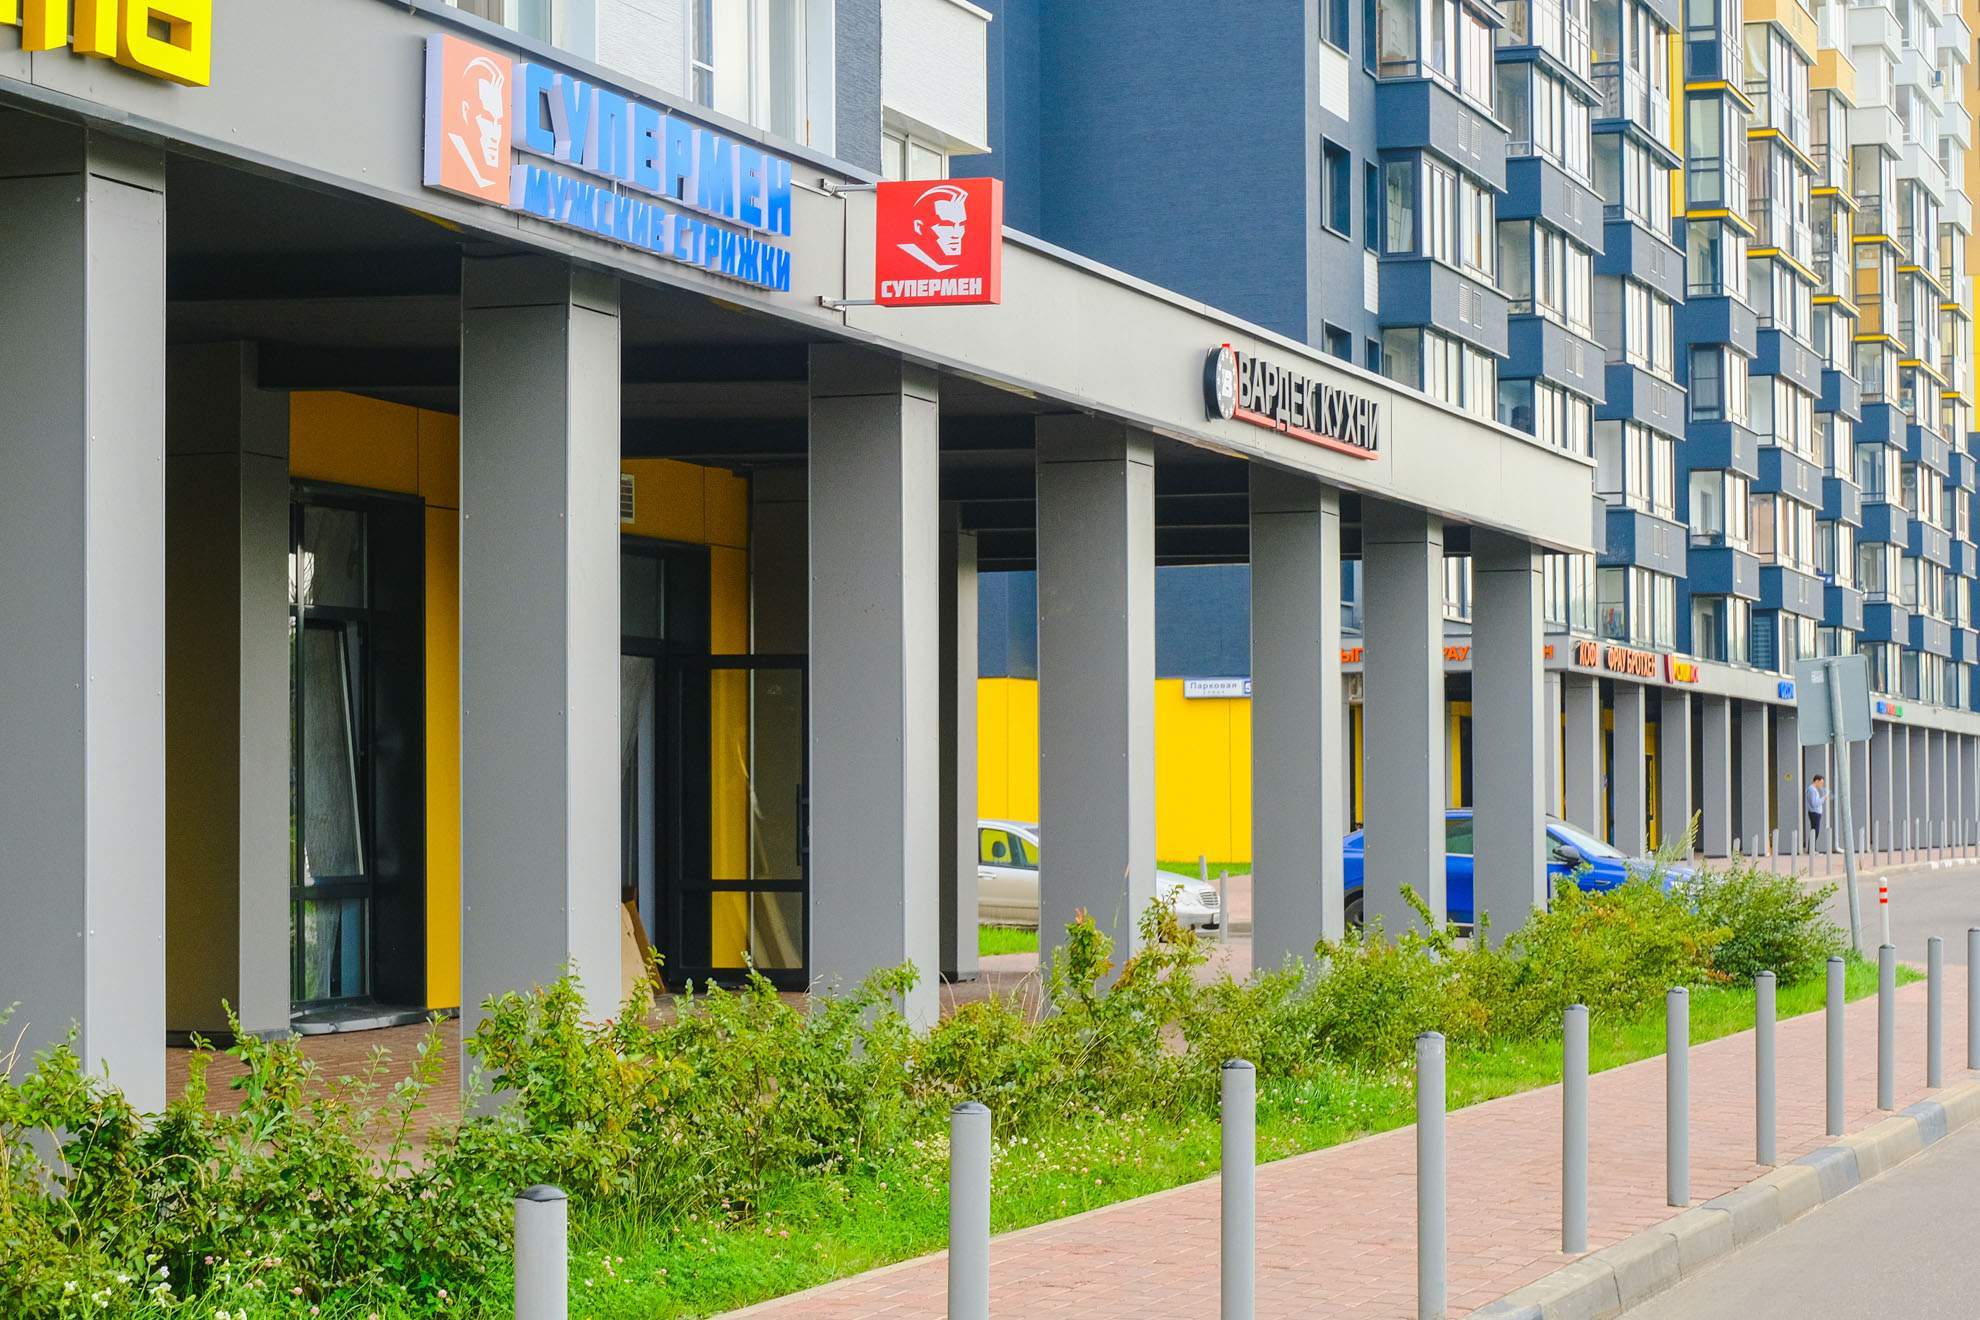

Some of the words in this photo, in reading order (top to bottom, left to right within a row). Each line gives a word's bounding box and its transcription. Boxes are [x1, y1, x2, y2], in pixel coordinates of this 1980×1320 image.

[513, 63, 792, 237] СУПЕРМЕН
[511, 164, 665, 253] МУЖСКИЕ
[666, 213, 791, 292] СТРИЖКИ
[881, 277, 983, 299] СУПЕРМЕН
[1236, 351, 1316, 433] ВАРДЕК
[1316, 383, 1381, 451] КУХНИ
[1190, 681, 1237, 690] Парковая
